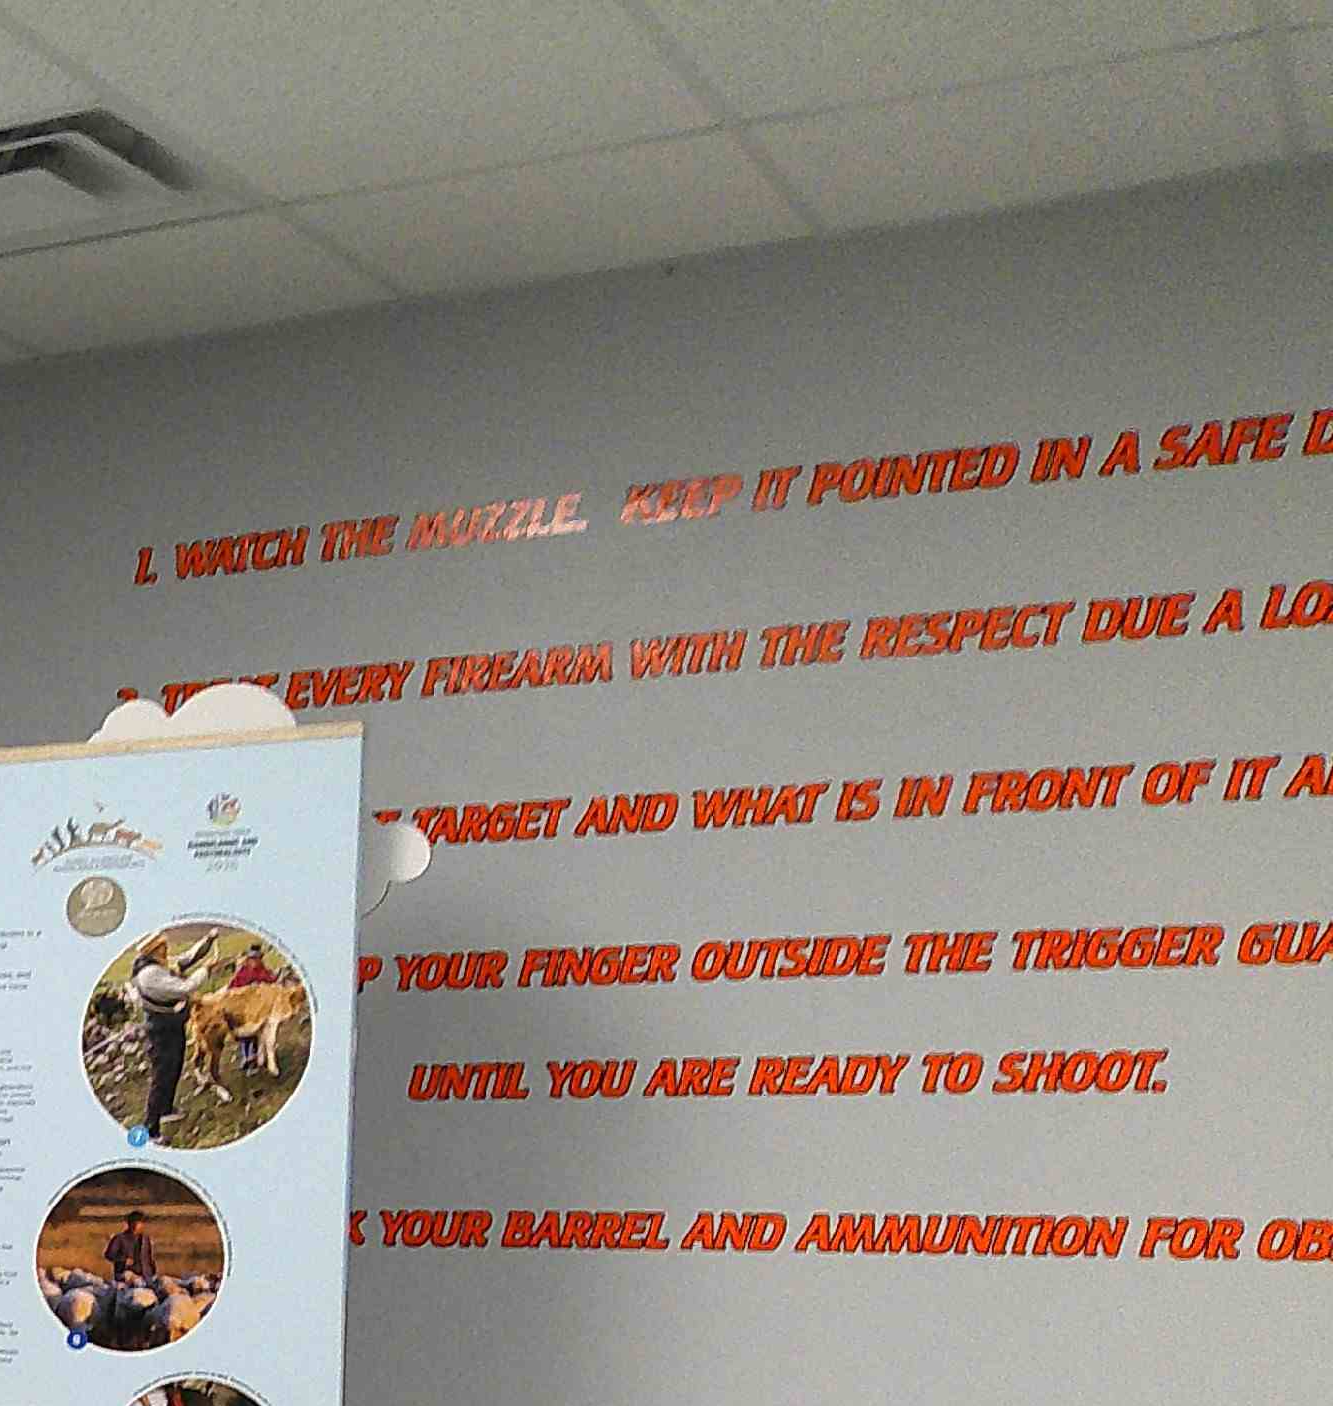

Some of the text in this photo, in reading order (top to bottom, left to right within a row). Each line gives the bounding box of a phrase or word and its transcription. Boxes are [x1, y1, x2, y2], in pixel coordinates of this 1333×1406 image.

[174, 526, 311, 578] WATCH
[321, 514, 399, 561] THE
[406, 493, 589, 551] MUZZLE.
[619, 473, 744, 525] KEEP
[752, 464, 802, 513] IT
[806, 442, 1021, 506] POINTED
[1028, 435, 1092, 482] IN
[1099, 430, 1140, 477] A
[1151, 413, 1293, 471] SAFE
[284, 659, 416, 709] EVERY
[422, 641, 614, 699] FIREARM
[628, 629, 748, 680] WITH
[759, 618, 850, 669] THE
[857, 598, 1075, 660] RESPECT
[1080, 591, 1195, 645] DUE
[1202, 586, 1243, 635] A
[1258, 578, 1333, 632] LO
[410, 752, 1333, 848] TARGET AND WHAT IS IN FRONT OF IT A
[395, 949, 509, 992] YOUR
[515, 942, 682, 989] FINGER
[690, 932, 893, 984] OUTSIDE
[903, 929, 999, 975] THE
[1011, 921, 1227, 973] TRIGGER
[406, 1047, 1169, 1101] UNTIL YOU ARE READY TO SHOOT.
[379, 1207, 494, 1249] YOUR
[499, 1208, 670, 1252] BARREL
[679, 1209, 788, 1254] AND
[792, 1210, 1132, 1260] AMMUNITION
[1138, 1214, 1246, 1262] FOR
[1254, 1217, 1333, 1265] OB
